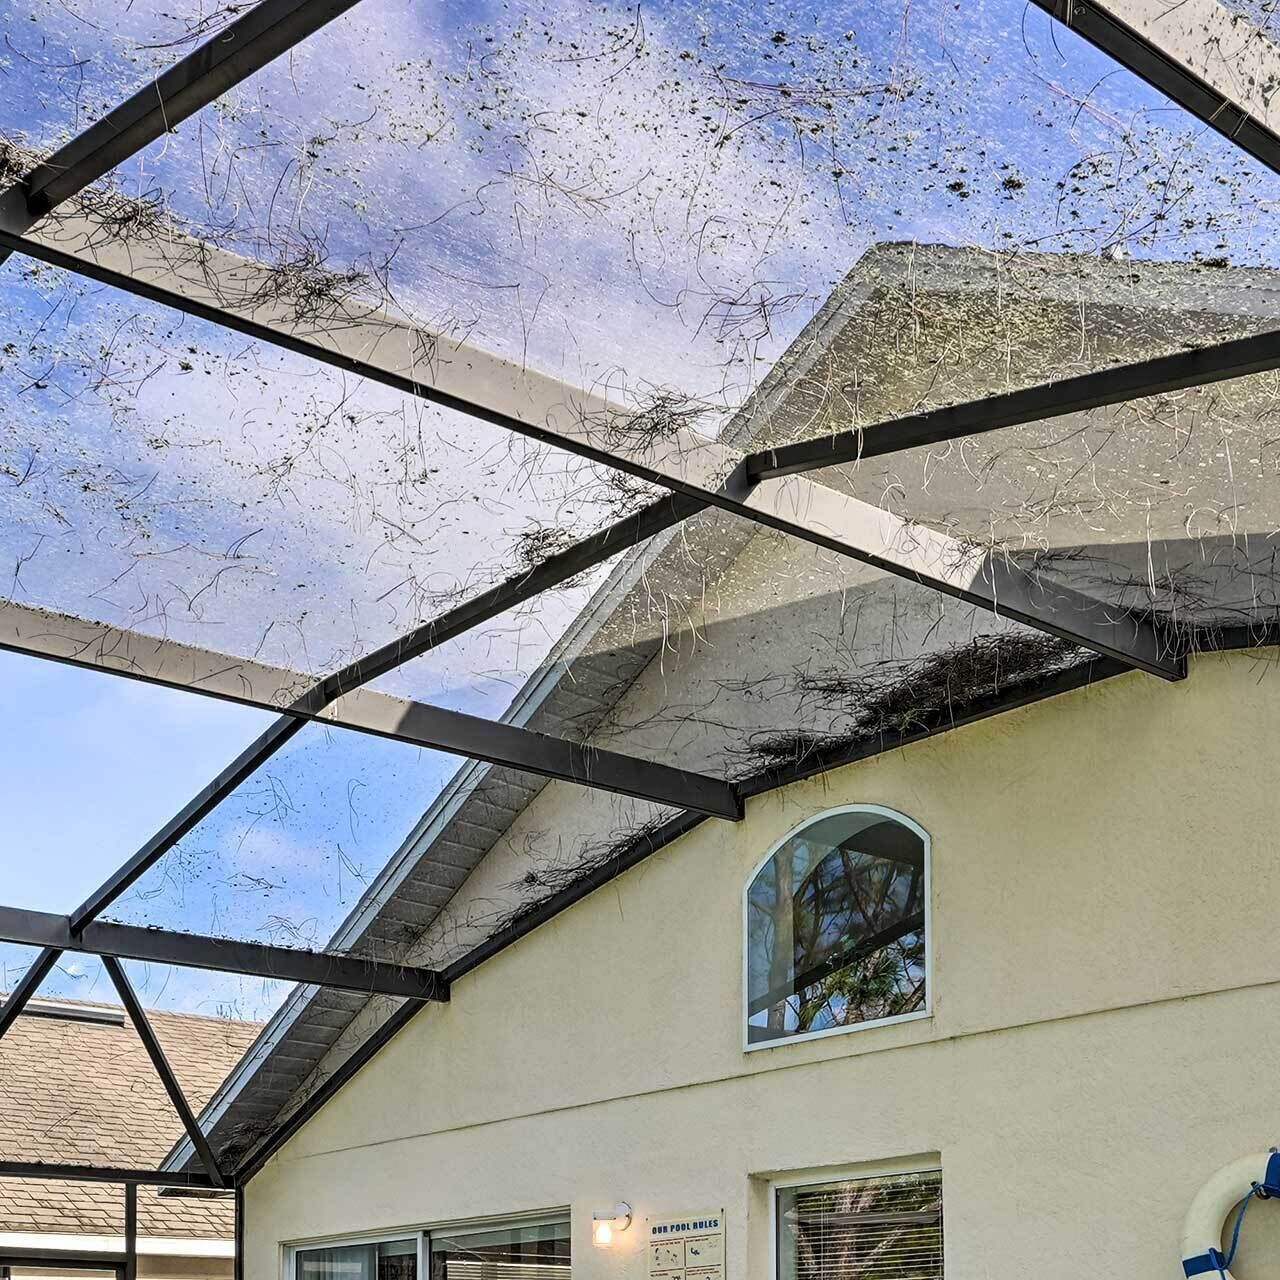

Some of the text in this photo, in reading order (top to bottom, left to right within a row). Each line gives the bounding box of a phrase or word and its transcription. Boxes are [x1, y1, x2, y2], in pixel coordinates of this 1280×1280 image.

[652, 1219, 719, 1234] OUR POOL RULES
